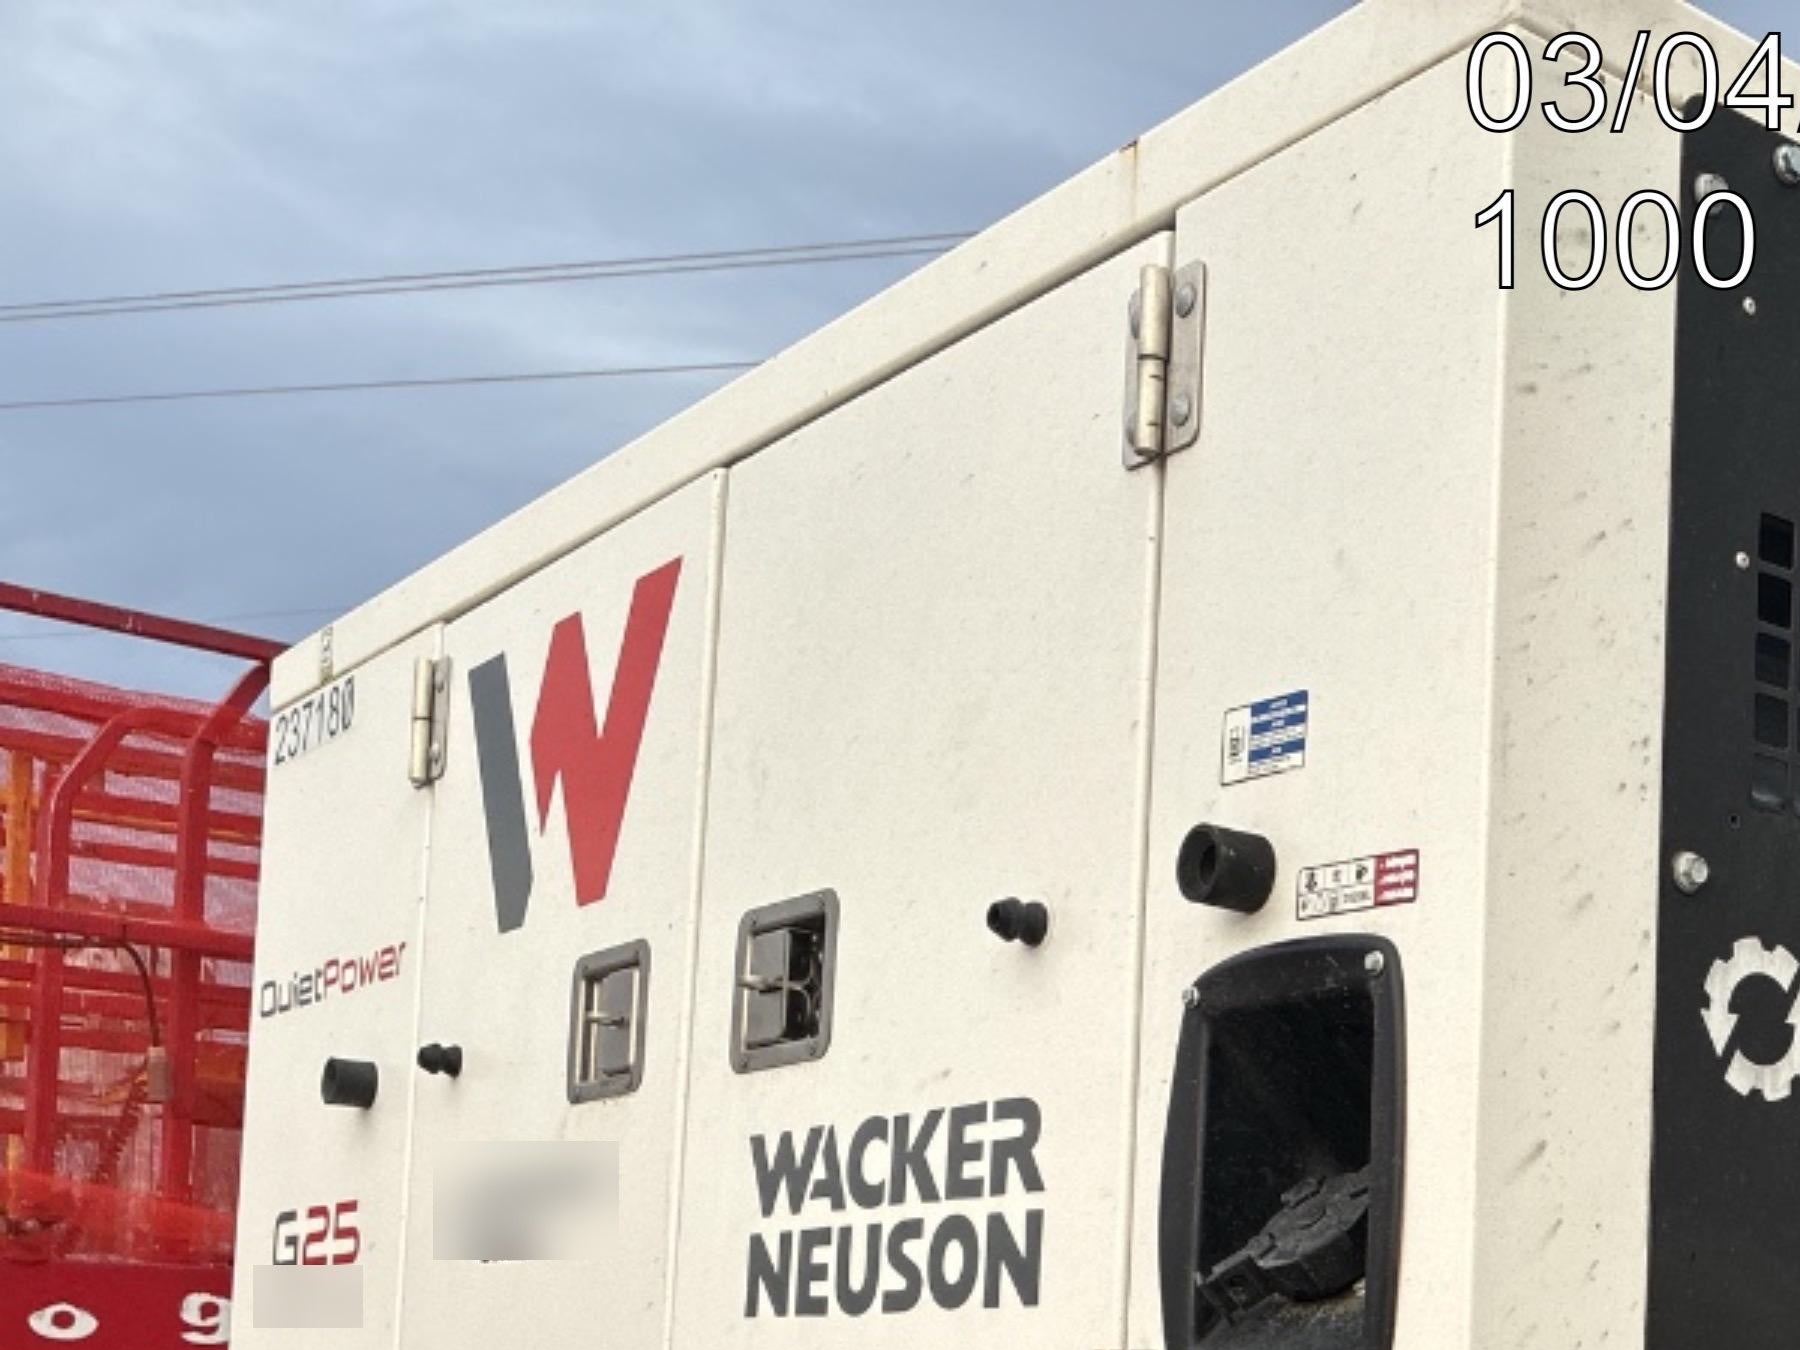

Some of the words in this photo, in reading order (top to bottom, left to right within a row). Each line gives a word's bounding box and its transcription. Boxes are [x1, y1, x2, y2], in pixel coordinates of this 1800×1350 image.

[273, 674, 356, 766] 237180
[260, 942, 406, 1018] QuietPower
[750, 1097, 1045, 1218] WACKER
[272, 1200, 361, 1265] G25
[744, 1208, 1045, 1317] NEUSON
